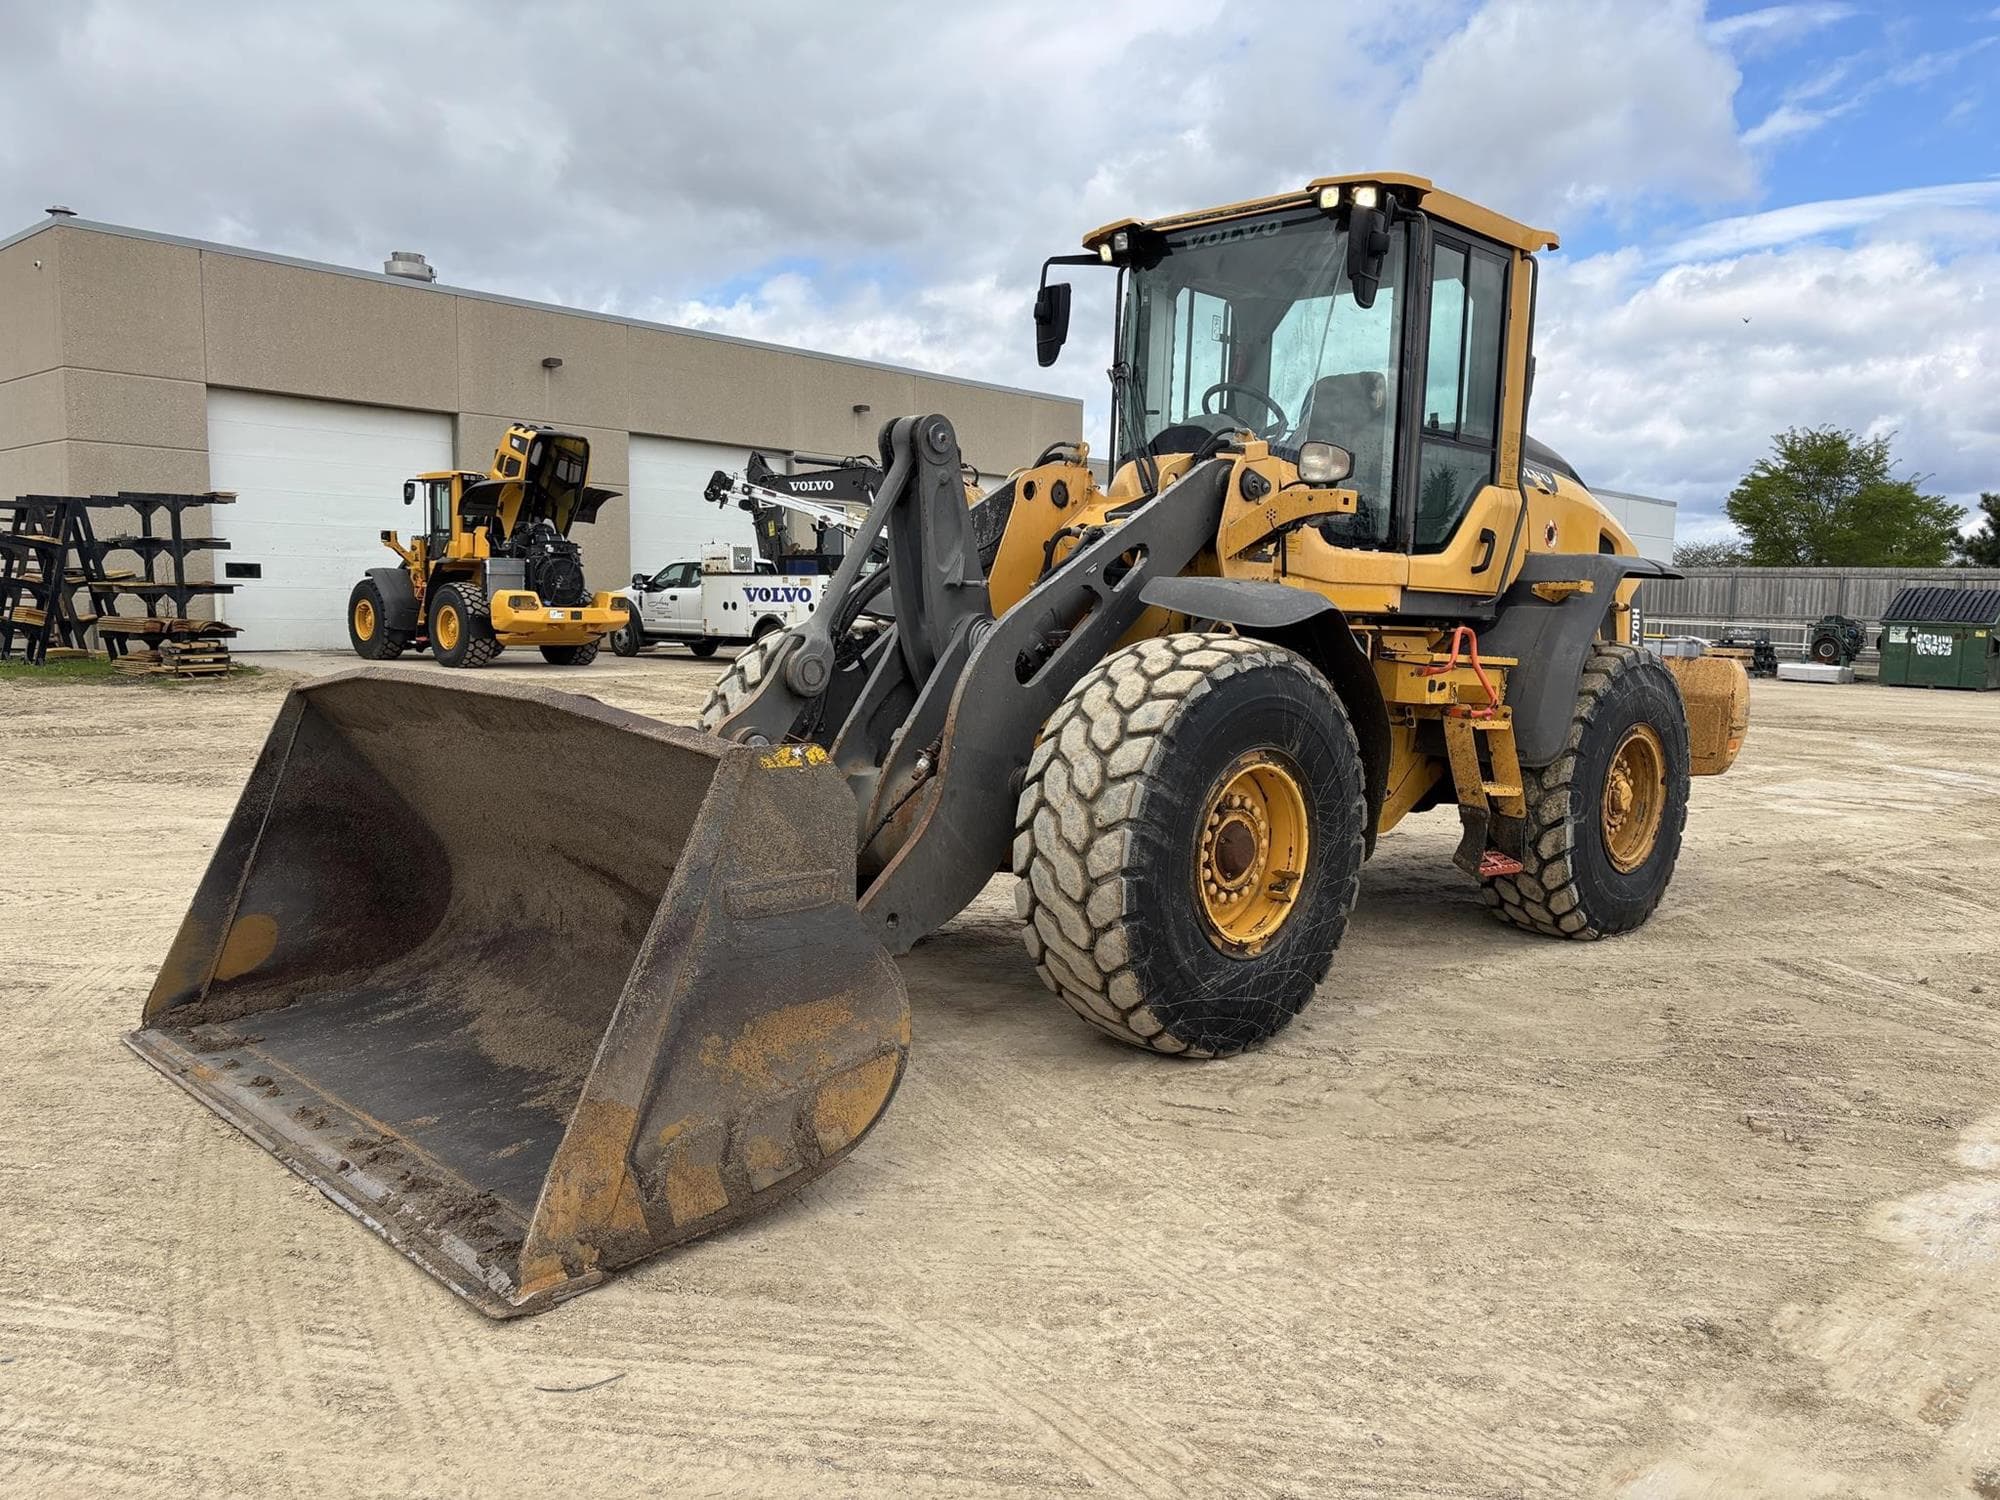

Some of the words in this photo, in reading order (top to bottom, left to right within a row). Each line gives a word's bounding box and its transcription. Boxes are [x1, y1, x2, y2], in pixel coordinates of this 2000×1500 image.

[1186, 219, 1283, 250] VOLVO
[789, 480, 834, 492] VOLVO
[742, 587, 812, 603] VOLVO
[1632, 608, 1640, 646] L70H
